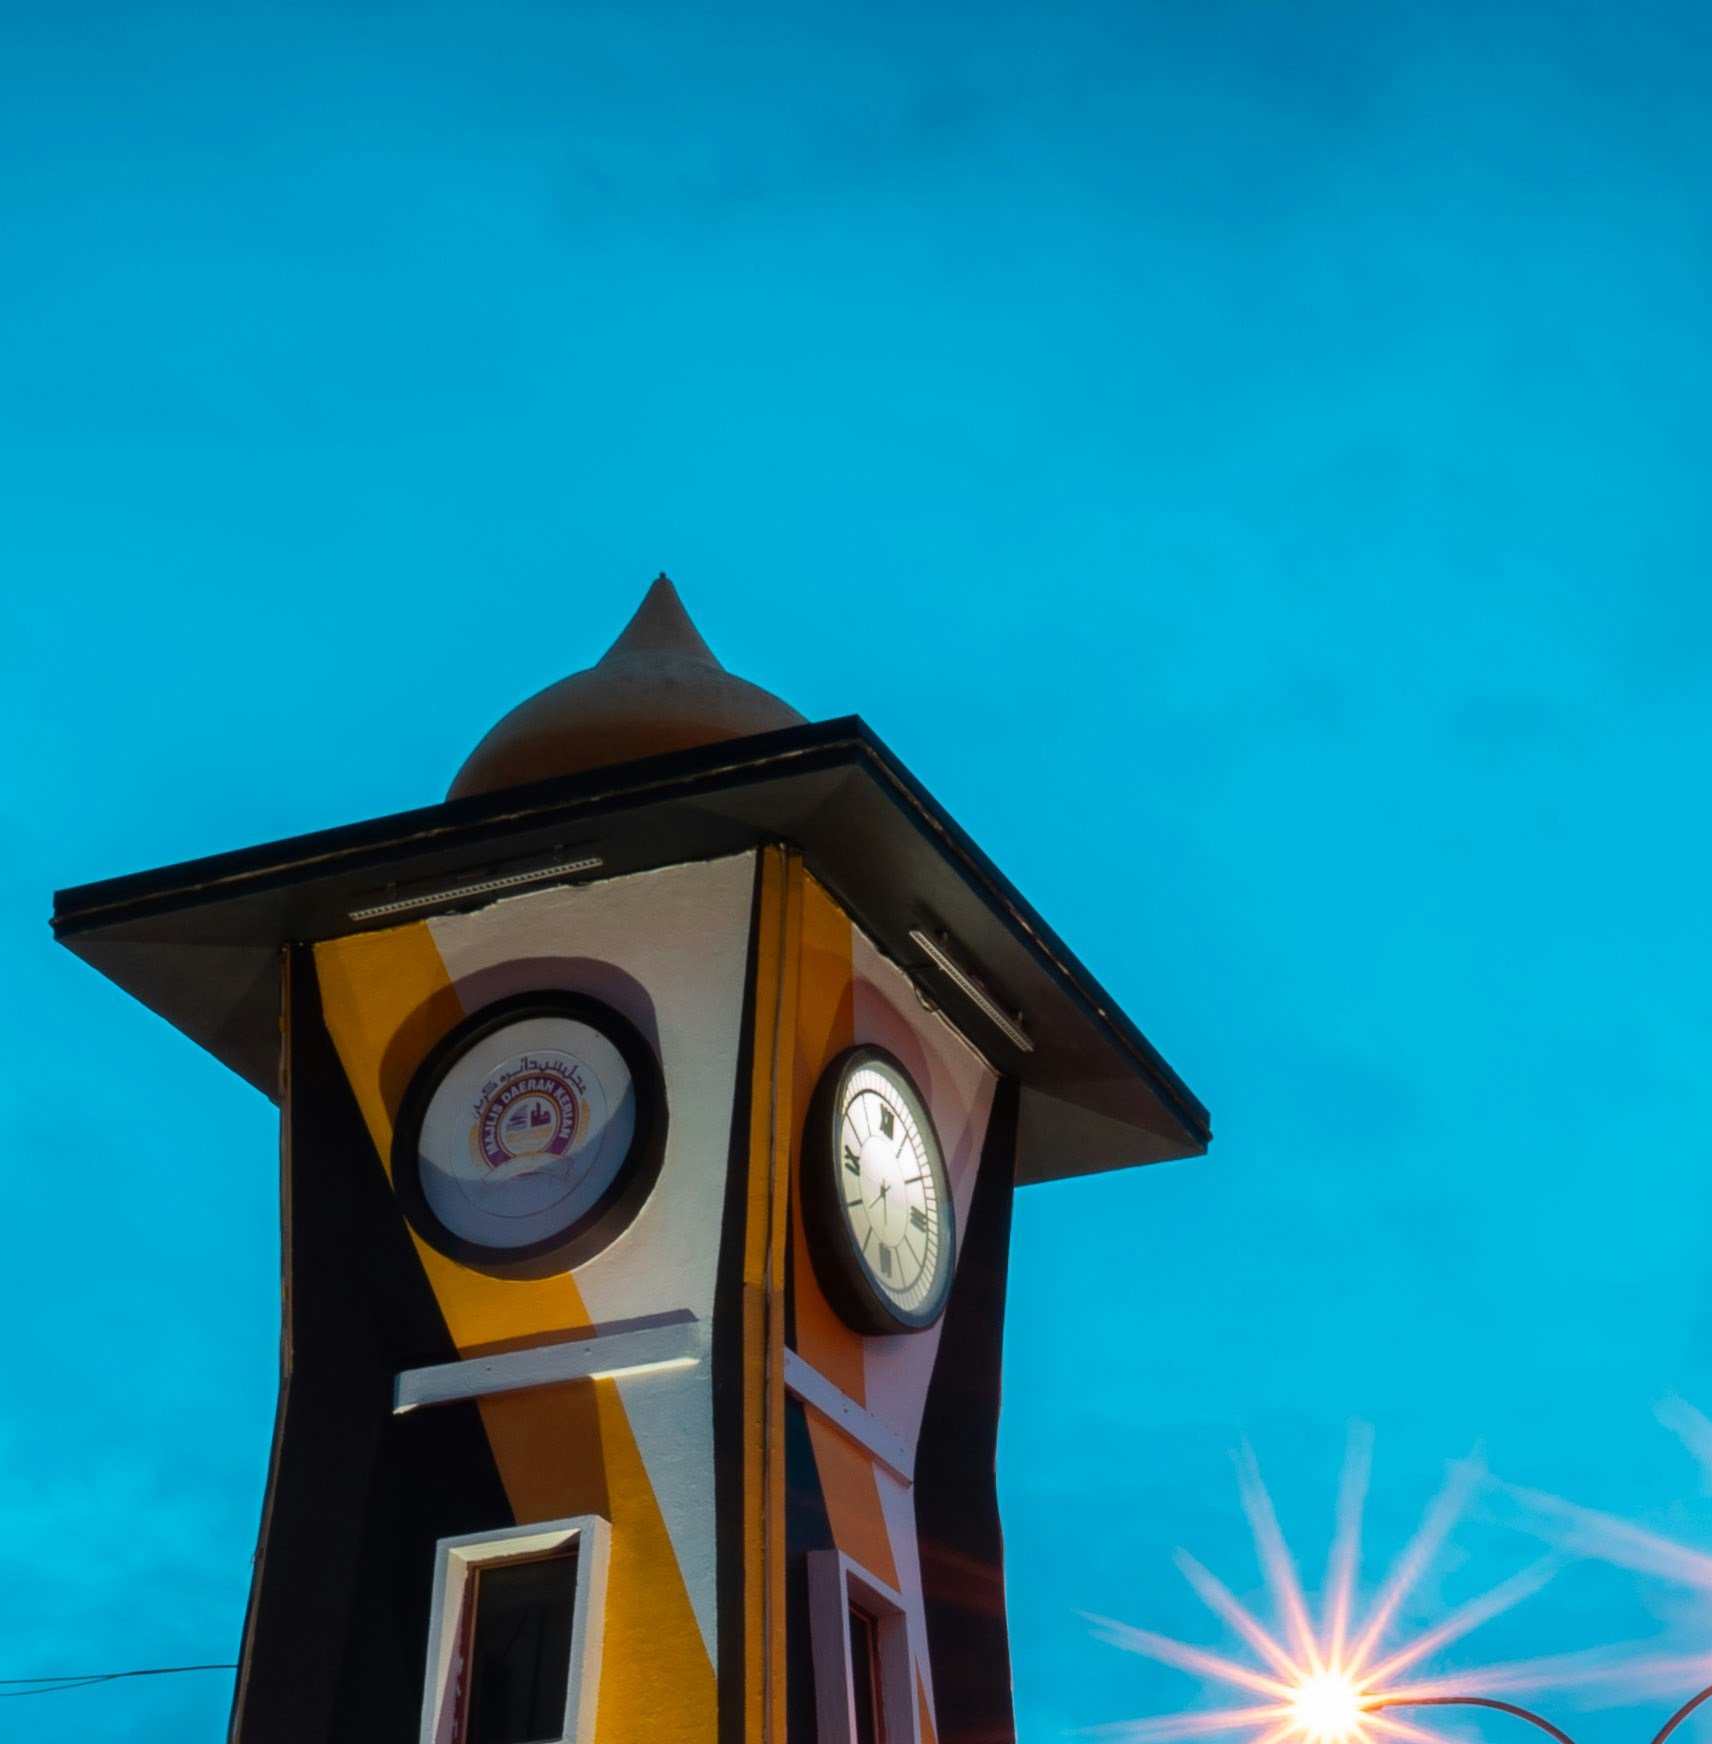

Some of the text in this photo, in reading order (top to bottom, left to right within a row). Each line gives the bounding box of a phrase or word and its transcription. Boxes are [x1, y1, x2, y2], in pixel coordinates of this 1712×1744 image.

[484, 1078, 573, 1155] MAJLIS DAERAH KERIAN
[845, 1145, 860, 1176] IX
